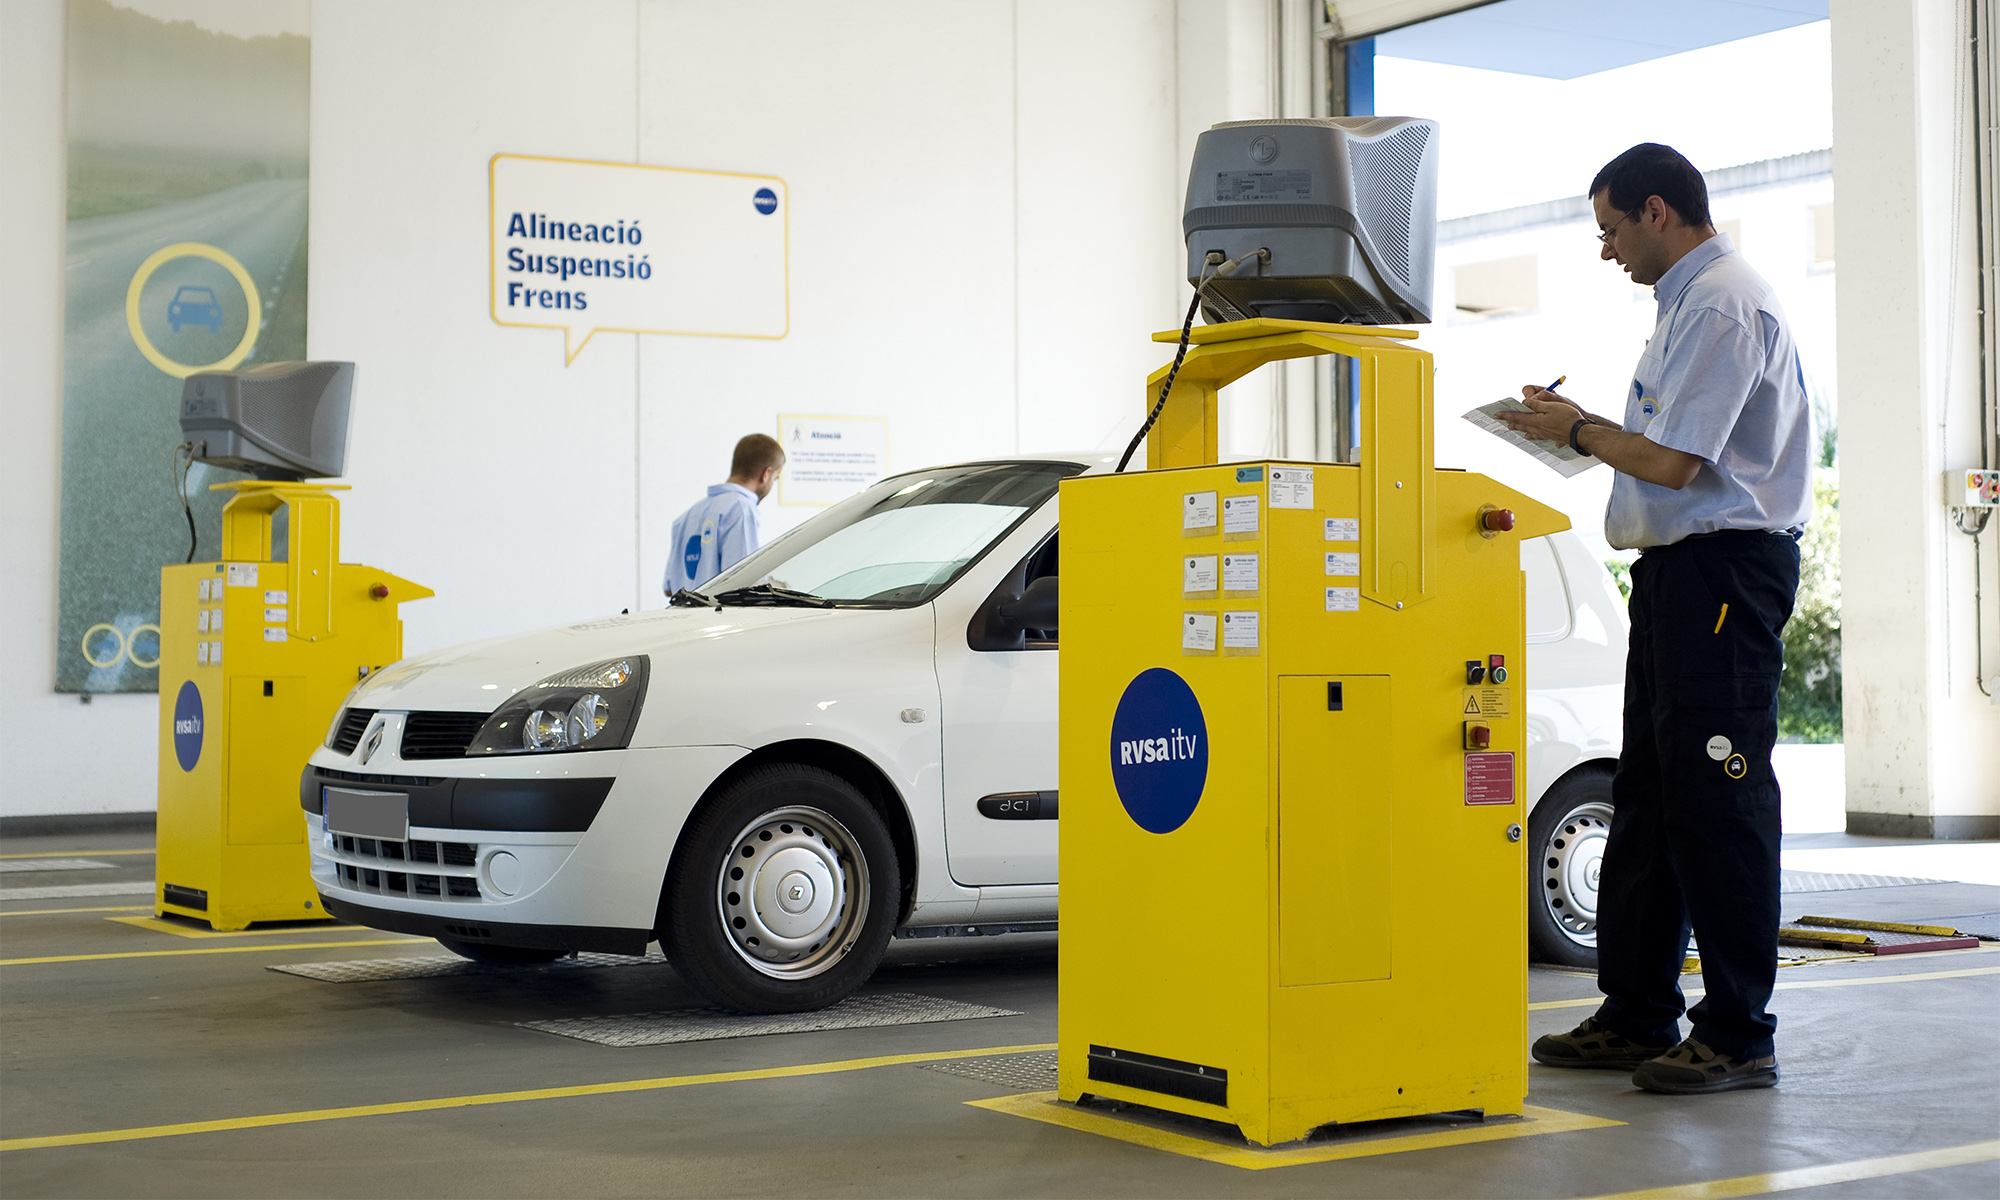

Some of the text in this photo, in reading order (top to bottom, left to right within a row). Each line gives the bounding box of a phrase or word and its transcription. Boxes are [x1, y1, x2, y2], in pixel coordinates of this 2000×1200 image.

[507, 211, 643, 246] Alineació
[507, 247, 652, 282] Suspensió
[507, 281, 588, 312] Frens
